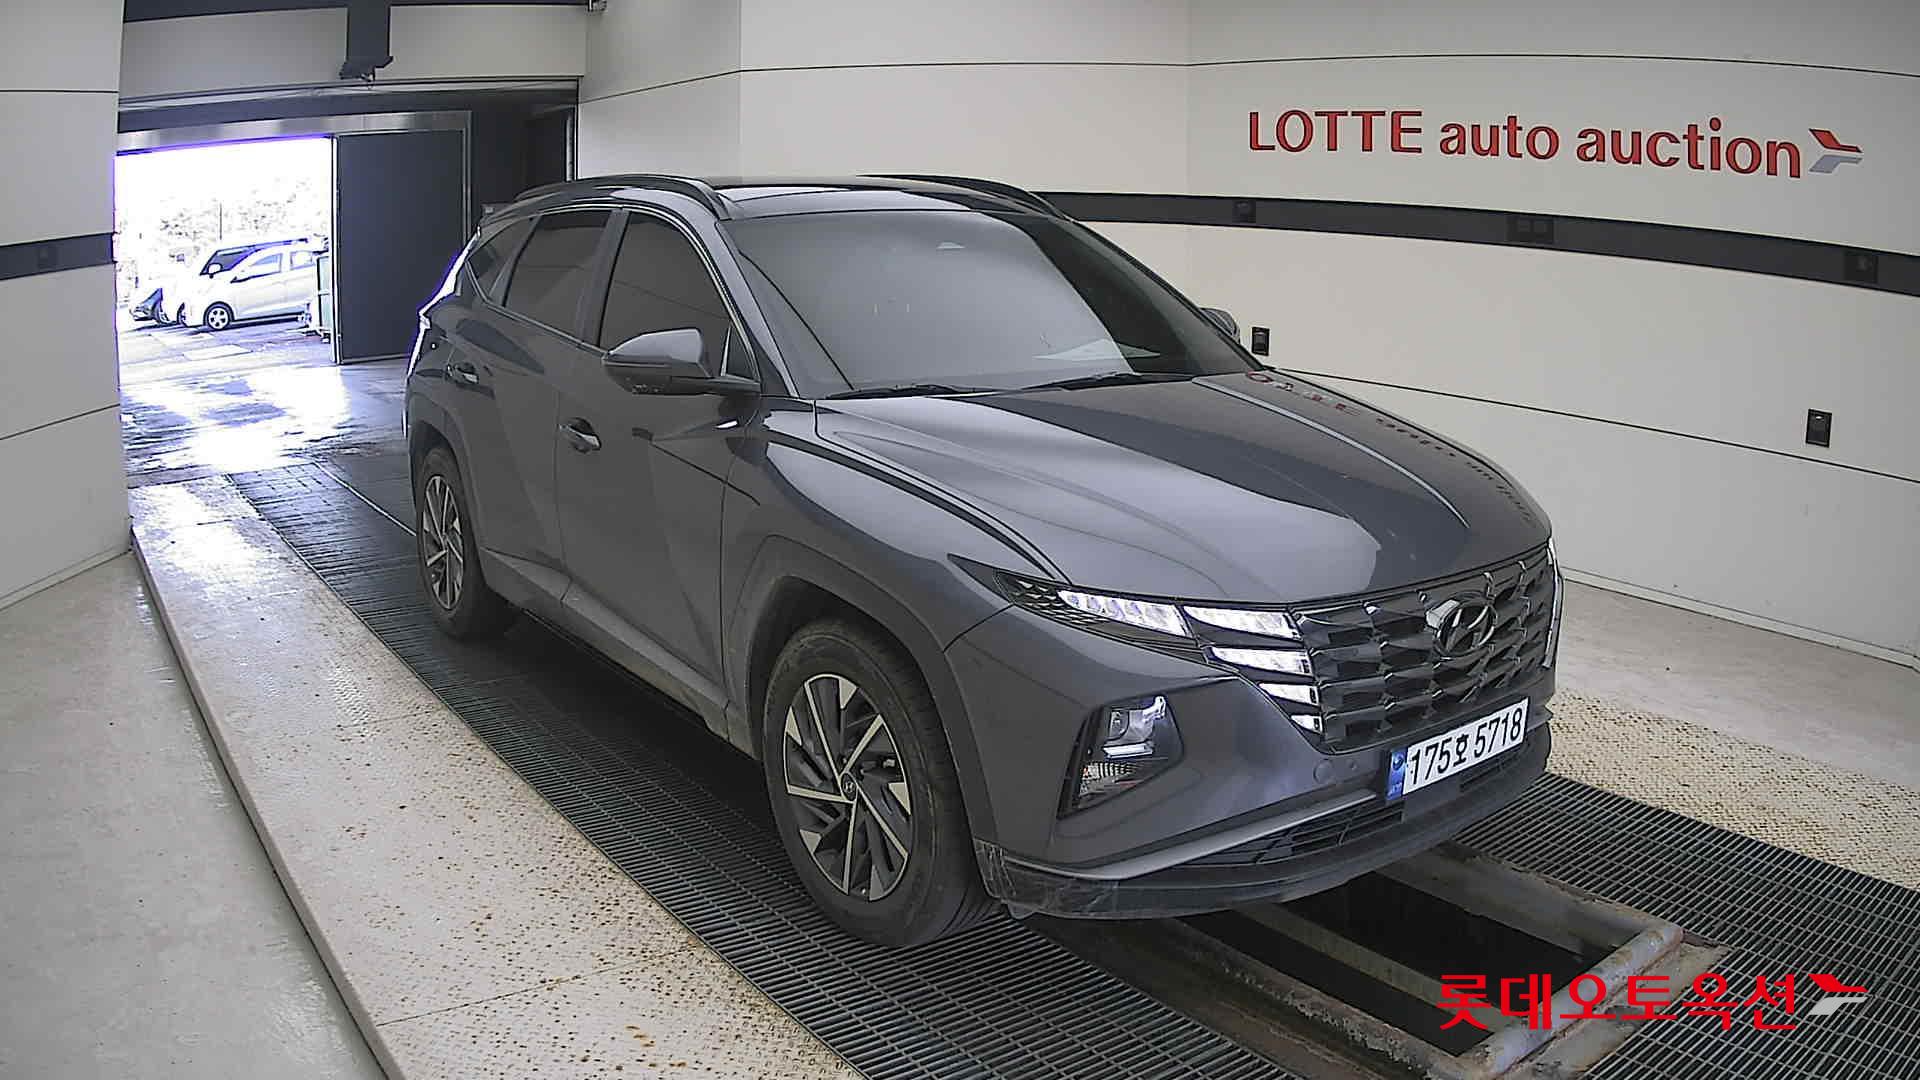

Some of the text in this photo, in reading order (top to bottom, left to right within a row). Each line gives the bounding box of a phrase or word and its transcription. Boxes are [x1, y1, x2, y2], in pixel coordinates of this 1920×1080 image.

[1248, 110, 1801, 179] LOTTE auto auction
[1473, 707, 1523, 758] 5718
